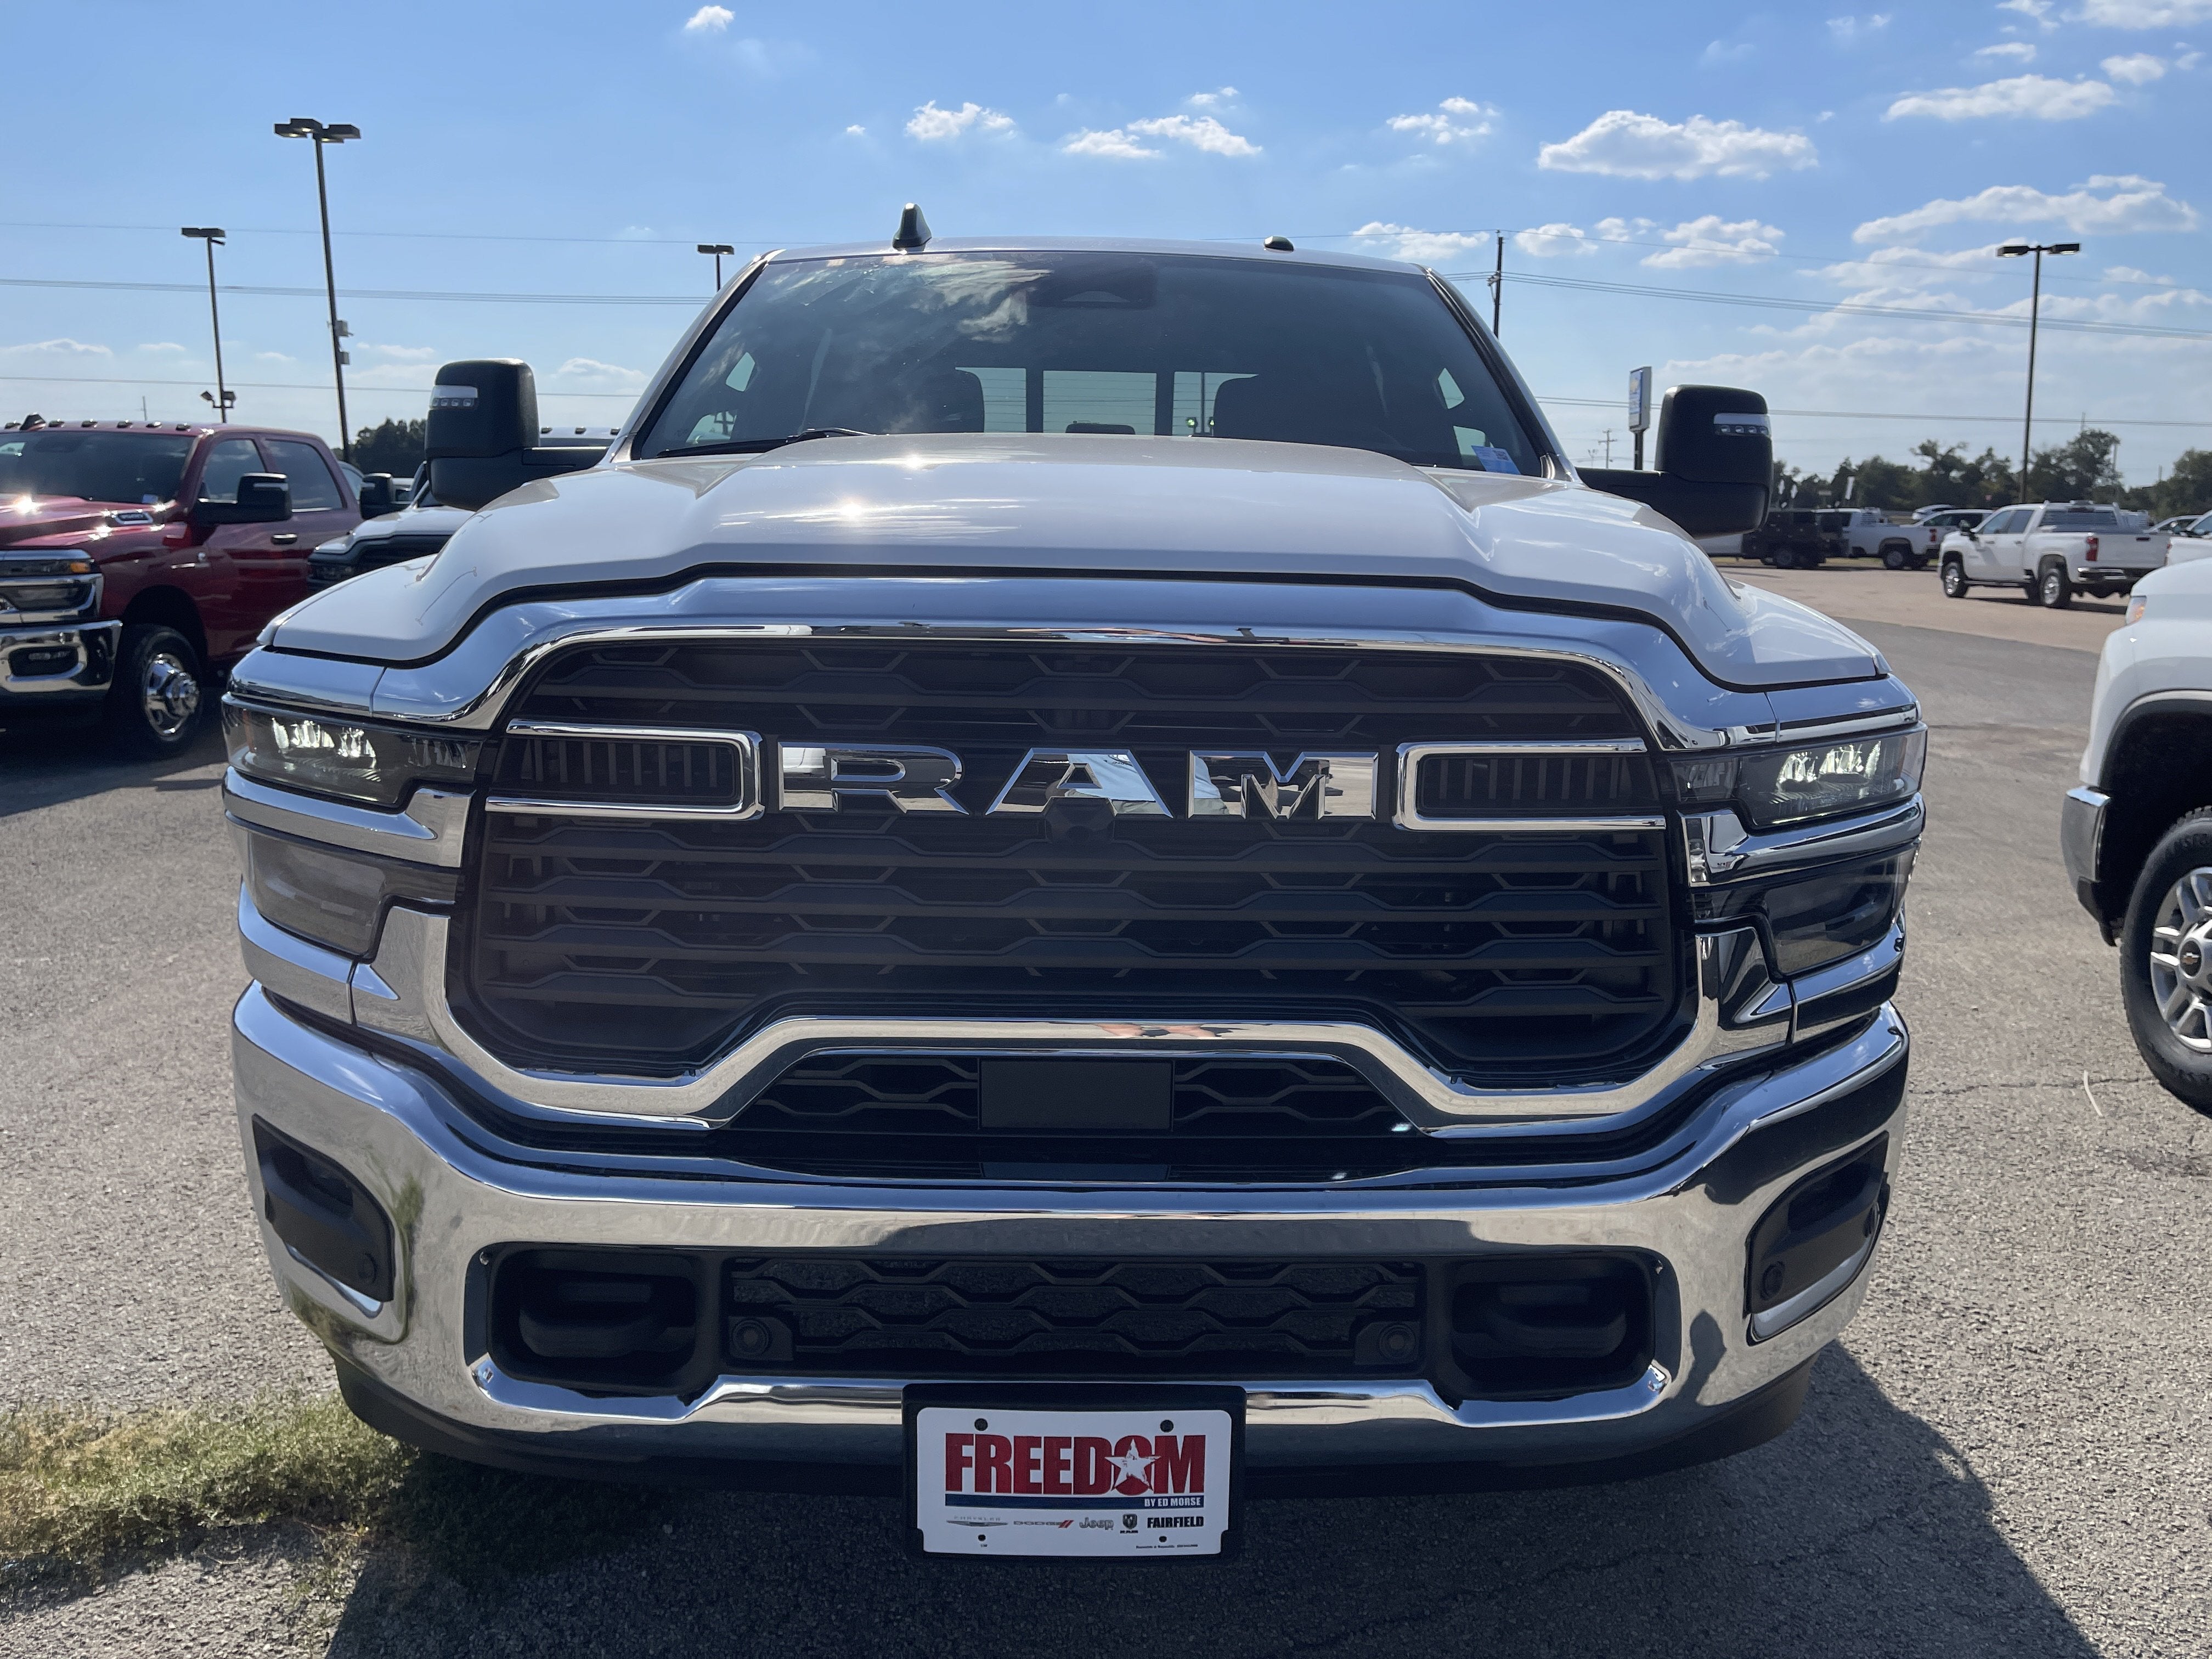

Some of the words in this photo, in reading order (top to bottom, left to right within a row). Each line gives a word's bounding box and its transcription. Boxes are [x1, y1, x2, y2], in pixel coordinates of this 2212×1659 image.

[777, 741, 1379, 820] RAM
[945, 1432, 1206, 1496] FREEDOM
[1144, 1498, 1156, 1507] BY
[1158, 1498, 1169, 1507] ED
[1170, 1497, 1201, 1506] MORSE
[1079, 1517, 1115, 1530] Jeep
[1147, 1516, 1204, 1528] FAIRFIELD
